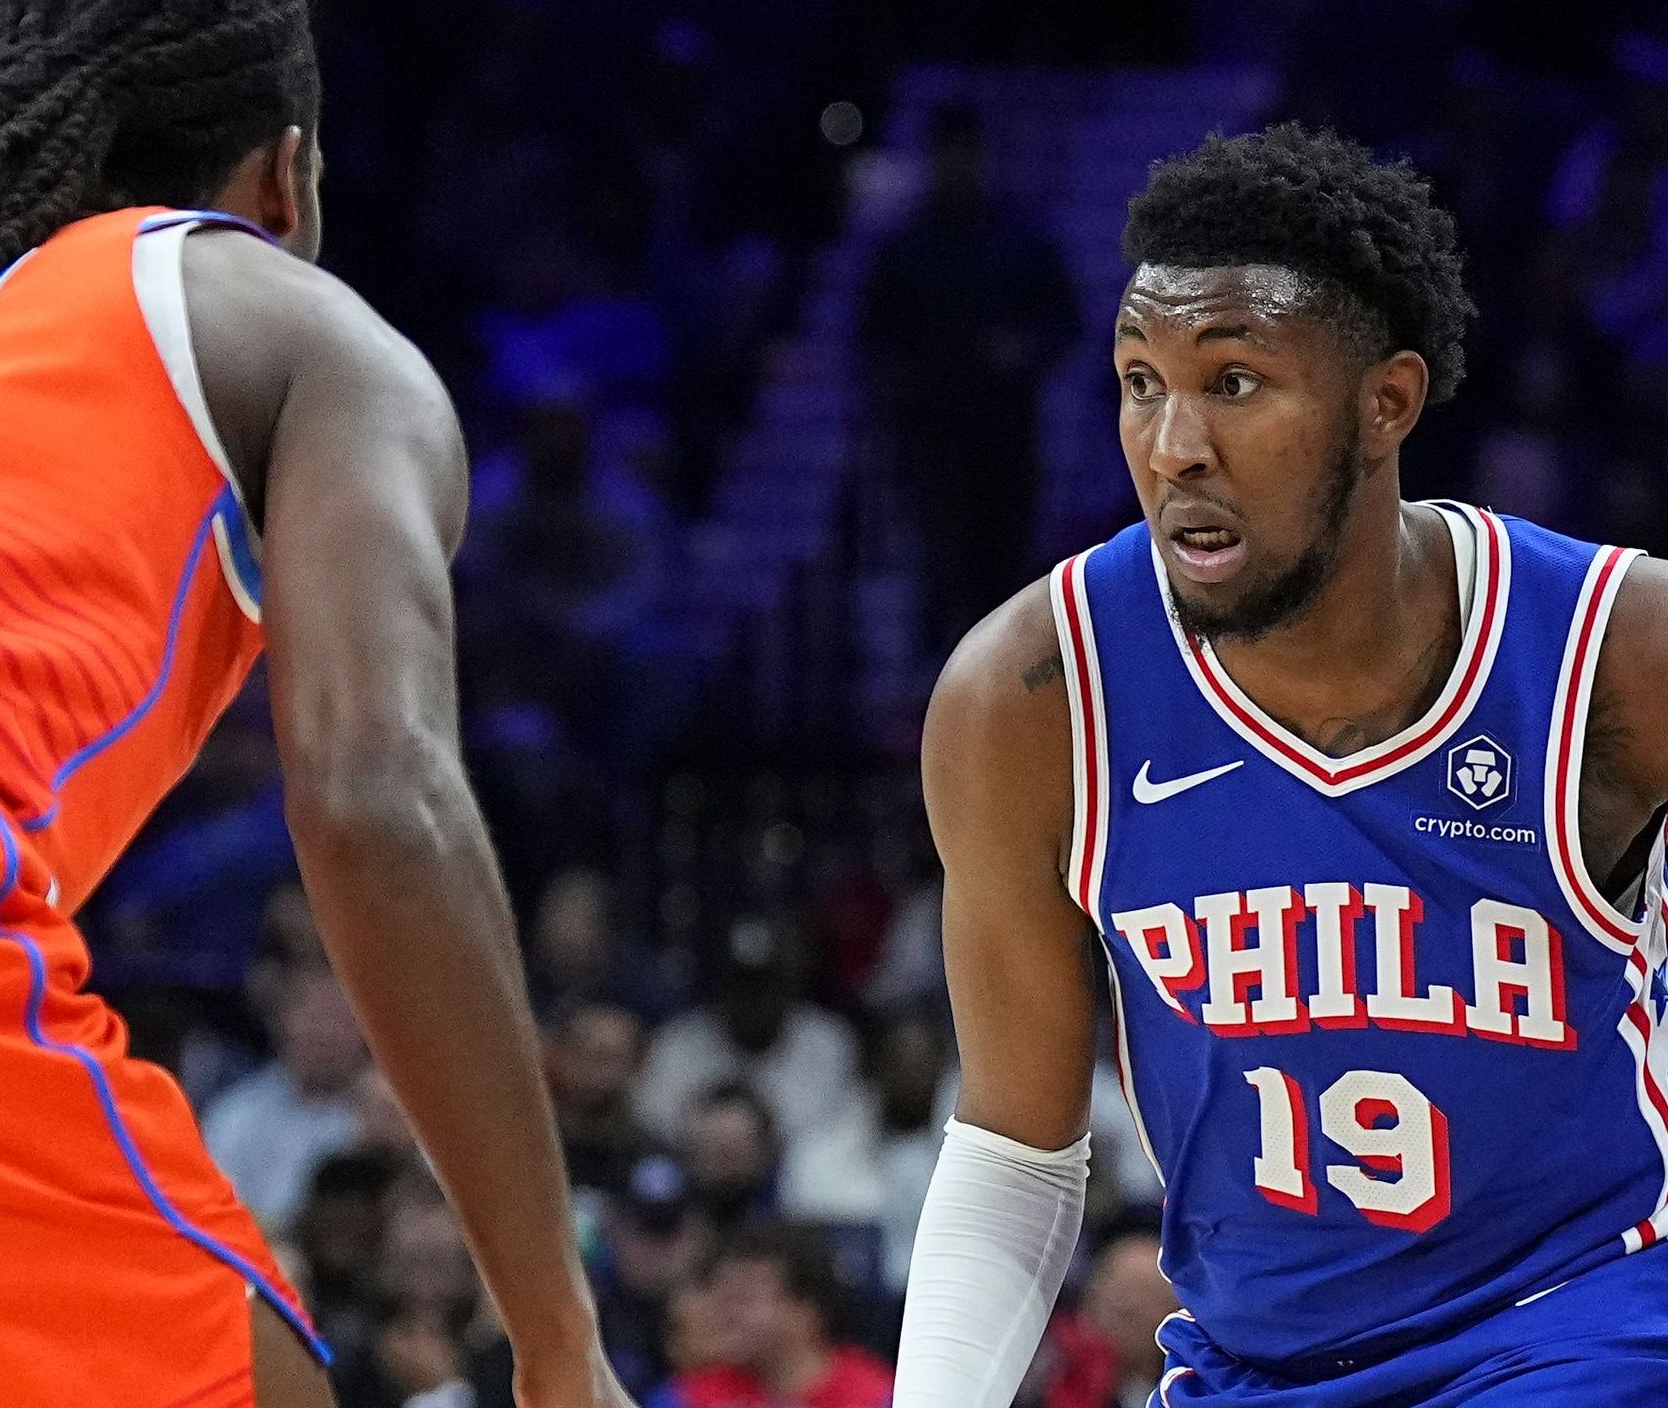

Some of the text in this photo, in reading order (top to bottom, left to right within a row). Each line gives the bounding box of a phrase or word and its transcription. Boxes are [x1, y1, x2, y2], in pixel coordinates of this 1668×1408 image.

[1414, 816, 1536, 844] crypto.com
[1111, 882, 1578, 1051] PHILA
[1243, 1066, 1452, 1233] 19
